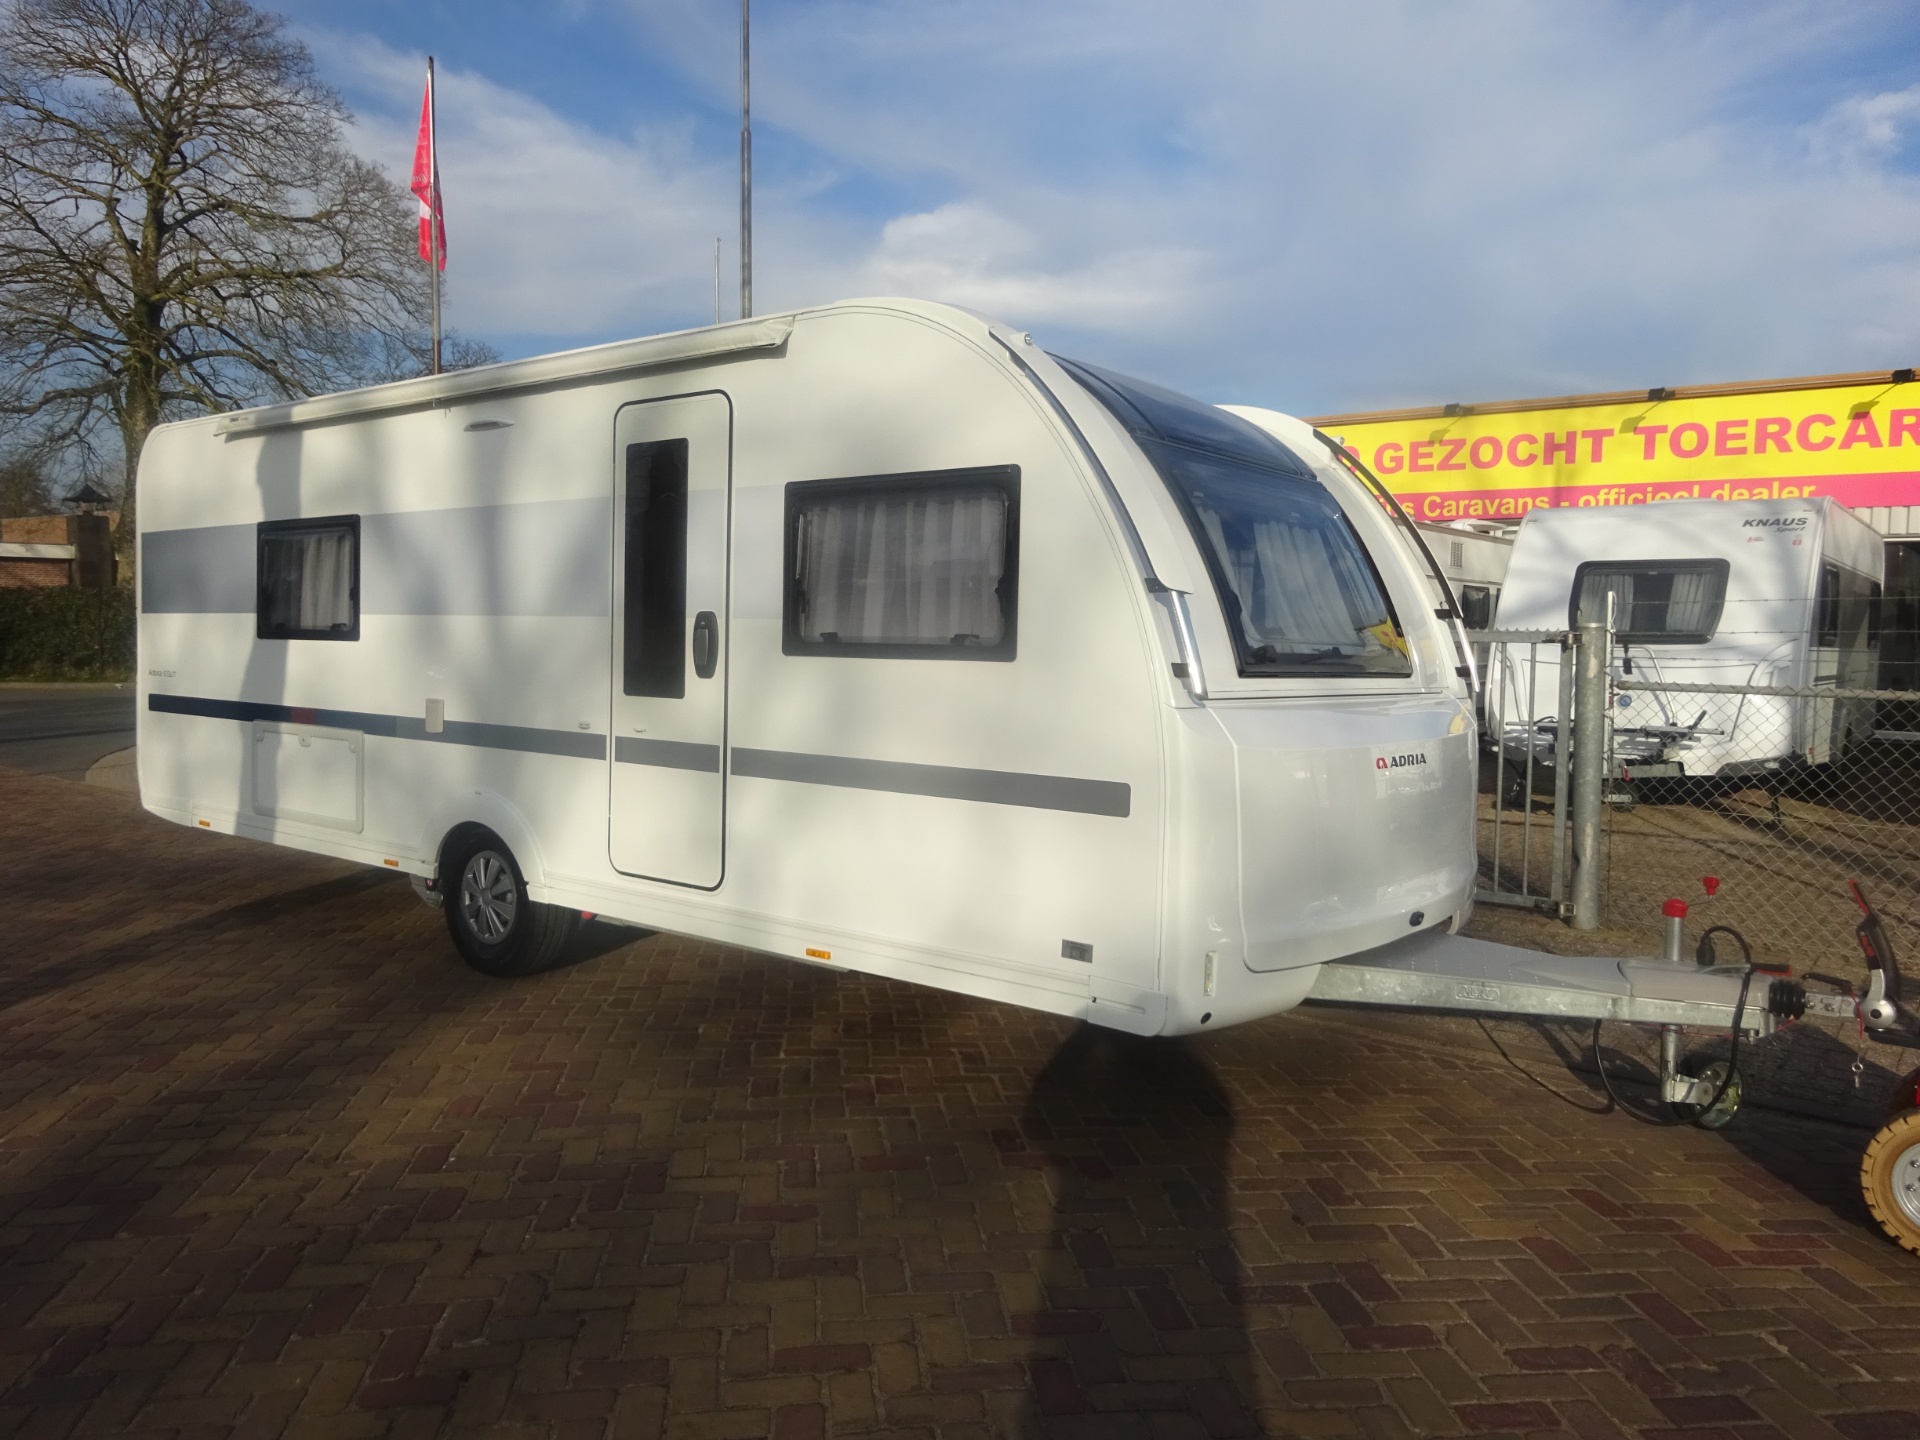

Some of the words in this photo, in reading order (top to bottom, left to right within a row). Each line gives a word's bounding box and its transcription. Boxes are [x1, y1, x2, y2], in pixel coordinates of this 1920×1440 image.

[1374, 428, 1615, 474] GEZOCHT
[1633, 408, 1920, 460] TOERCAR
[1424, 495, 1550, 517] Caravans
[1711, 481, 1816, 501] dealer
[1742, 517, 1808, 528] KNAUS
[1774, 526, 1806, 534] Sport
[1389, 752, 1427, 768] ADRIA
